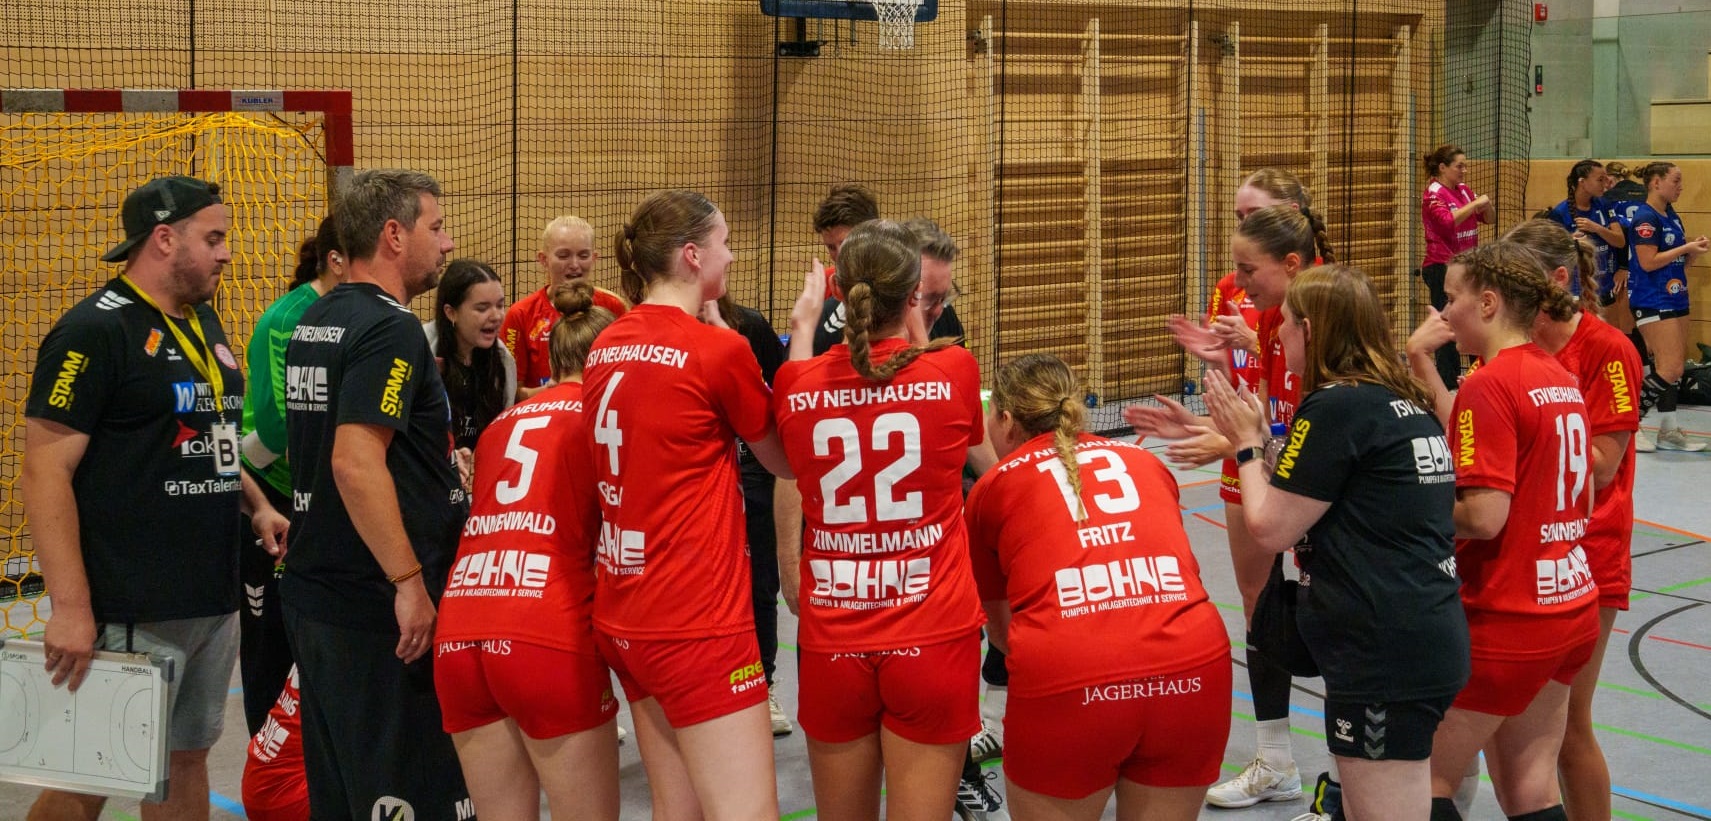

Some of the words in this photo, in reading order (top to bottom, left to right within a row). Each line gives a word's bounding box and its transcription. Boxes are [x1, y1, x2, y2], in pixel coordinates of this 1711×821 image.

[599, 344, 689, 369] NEUHAUSEN
[48, 350, 85, 408] STAMM
[380, 357, 409, 416] STAMM
[787, 391, 820, 413] TSV
[823, 381, 952, 408] NEUHAUSEN
[1607, 360, 1633, 413] STAMM
[512, 400, 583, 417] NEUHAUS
[594, 371, 625, 477] 4
[1389, 399, 1415, 419] TSV
[218, 438, 235, 467] B
[495, 415, 552, 505] 5
[998, 452, 1031, 472] TSV
[1033, 439, 1146, 459] NEHAUSEN
[1276, 417, 1311, 479] STAMM
[1459, 409, 1475, 467] STAMM
[812, 411, 924, 524] 22
[1555, 412, 1588, 512] 19
[1035, 448, 1141, 523] 13
[1077, 521, 1136, 549] FRITZ
[448, 549, 552, 589] BOHNE
[809, 556, 931, 600] BOHNE
[1054, 555, 1186, 608] BOHNE
[517, 588, 544, 599] SERVICE
[1061, 605, 1090, 619] PUMPEN
[1098, 595, 1154, 612] ANLAGENTECHNIK
[1160, 592, 1188, 603] SERVICE
[121, 665, 153, 675] HANDBALL
